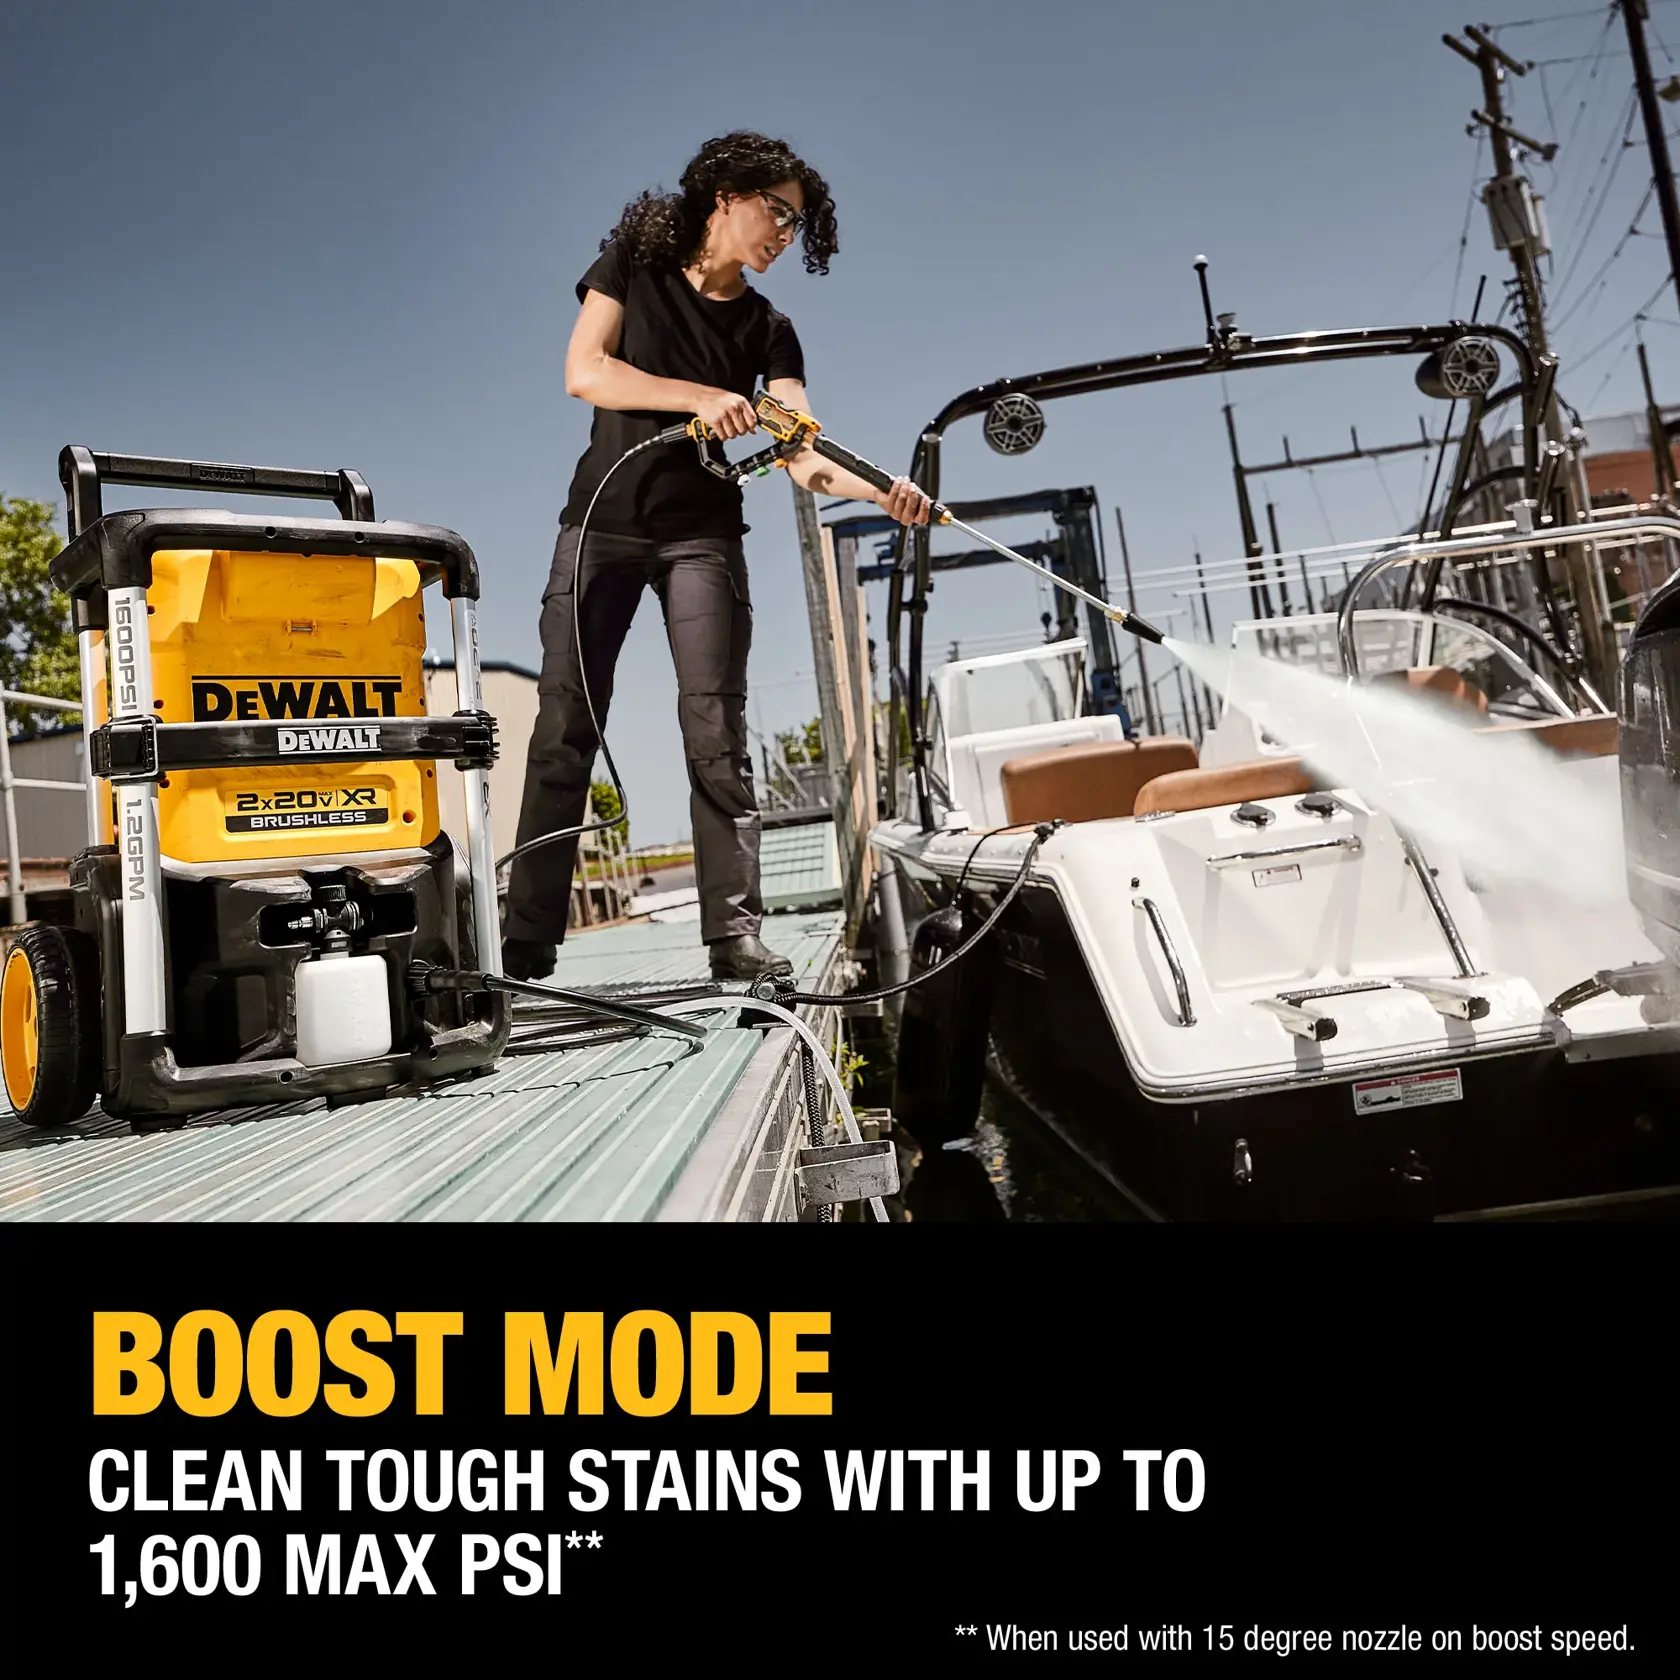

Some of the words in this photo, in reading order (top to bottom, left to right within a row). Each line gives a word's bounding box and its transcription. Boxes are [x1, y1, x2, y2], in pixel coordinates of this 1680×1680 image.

[115, 597, 138, 711] 1600PSI
[192, 681, 402, 722] DEWALT
[278, 728, 381, 751] DEWALT
[341, 788, 377, 807] XR
[250, 811, 367, 829] BRUSHLESS
[126, 799, 146, 901] 1.2GPM
